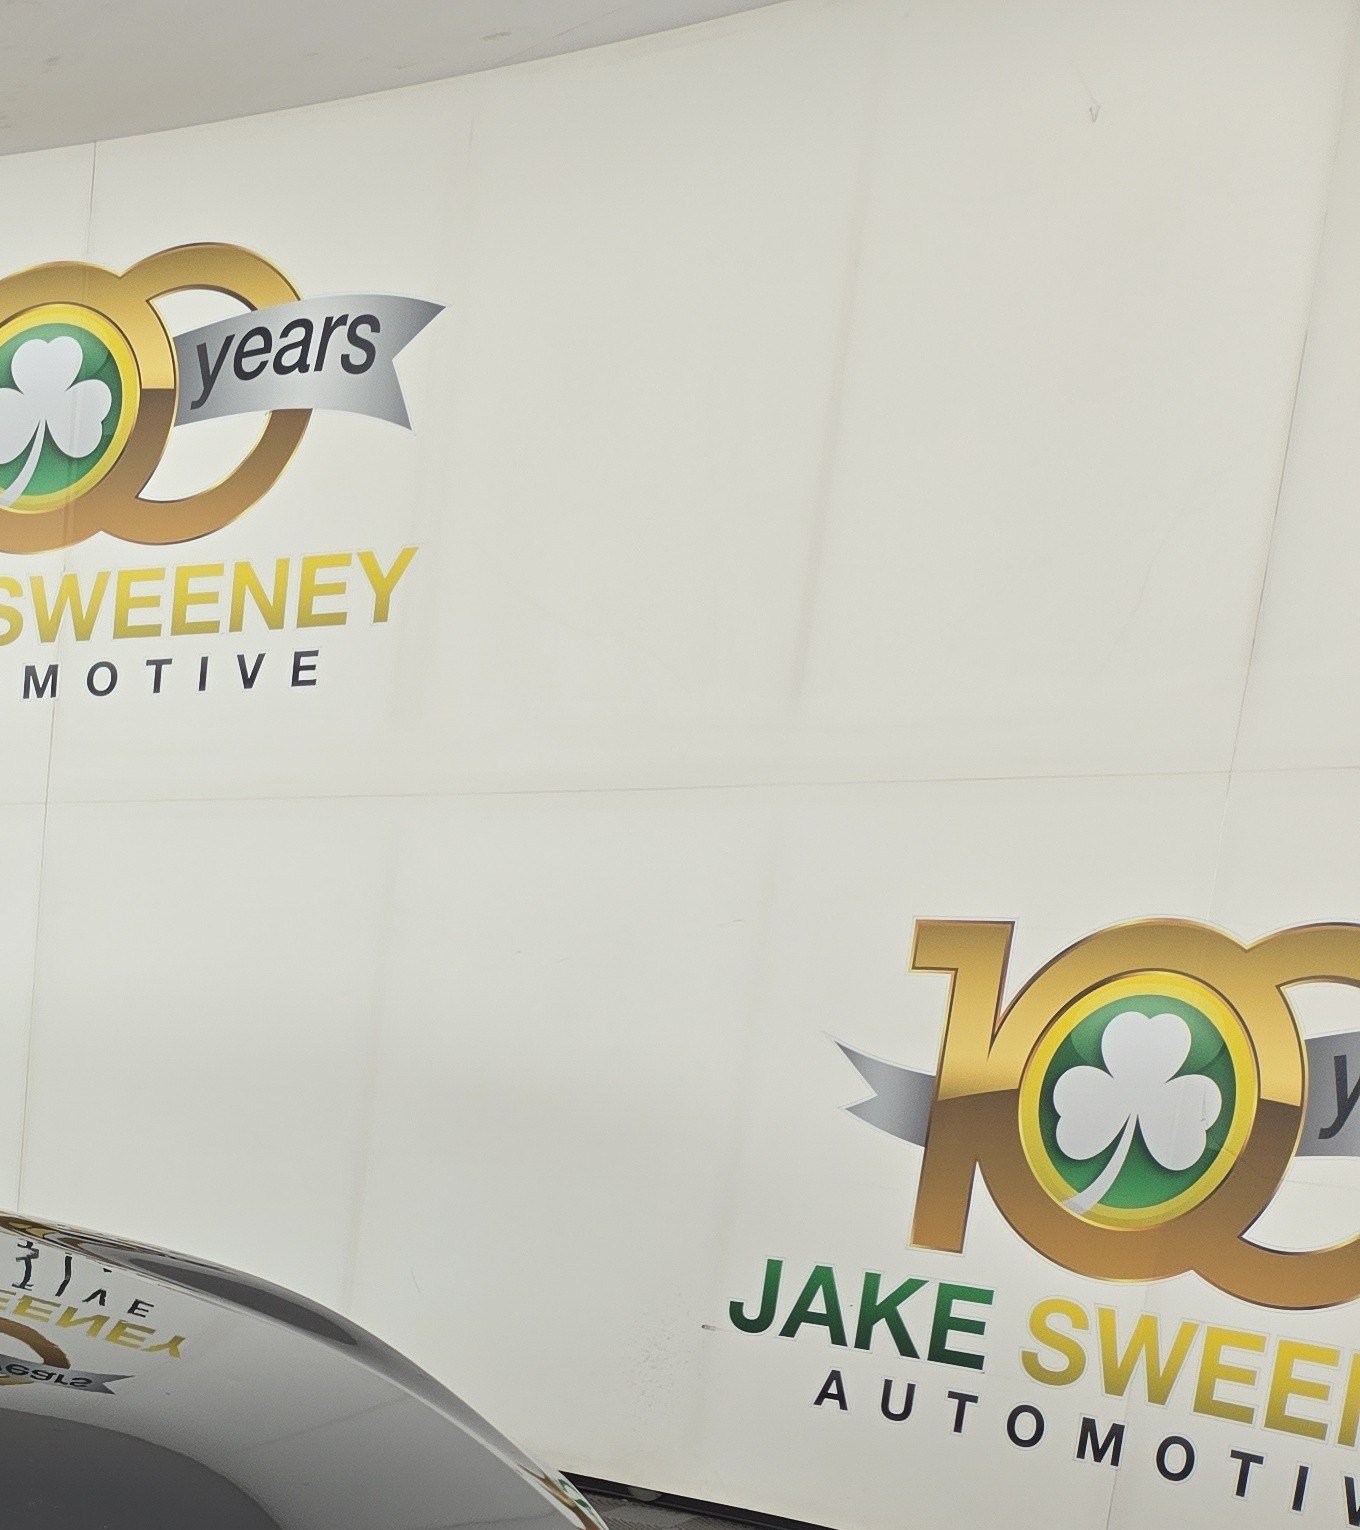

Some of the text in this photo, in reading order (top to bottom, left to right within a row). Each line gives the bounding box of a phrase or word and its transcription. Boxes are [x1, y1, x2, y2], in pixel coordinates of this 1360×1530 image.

[189, 311, 382, 410] years
[728, 1257, 1360, 1447] JAKE SWEE
